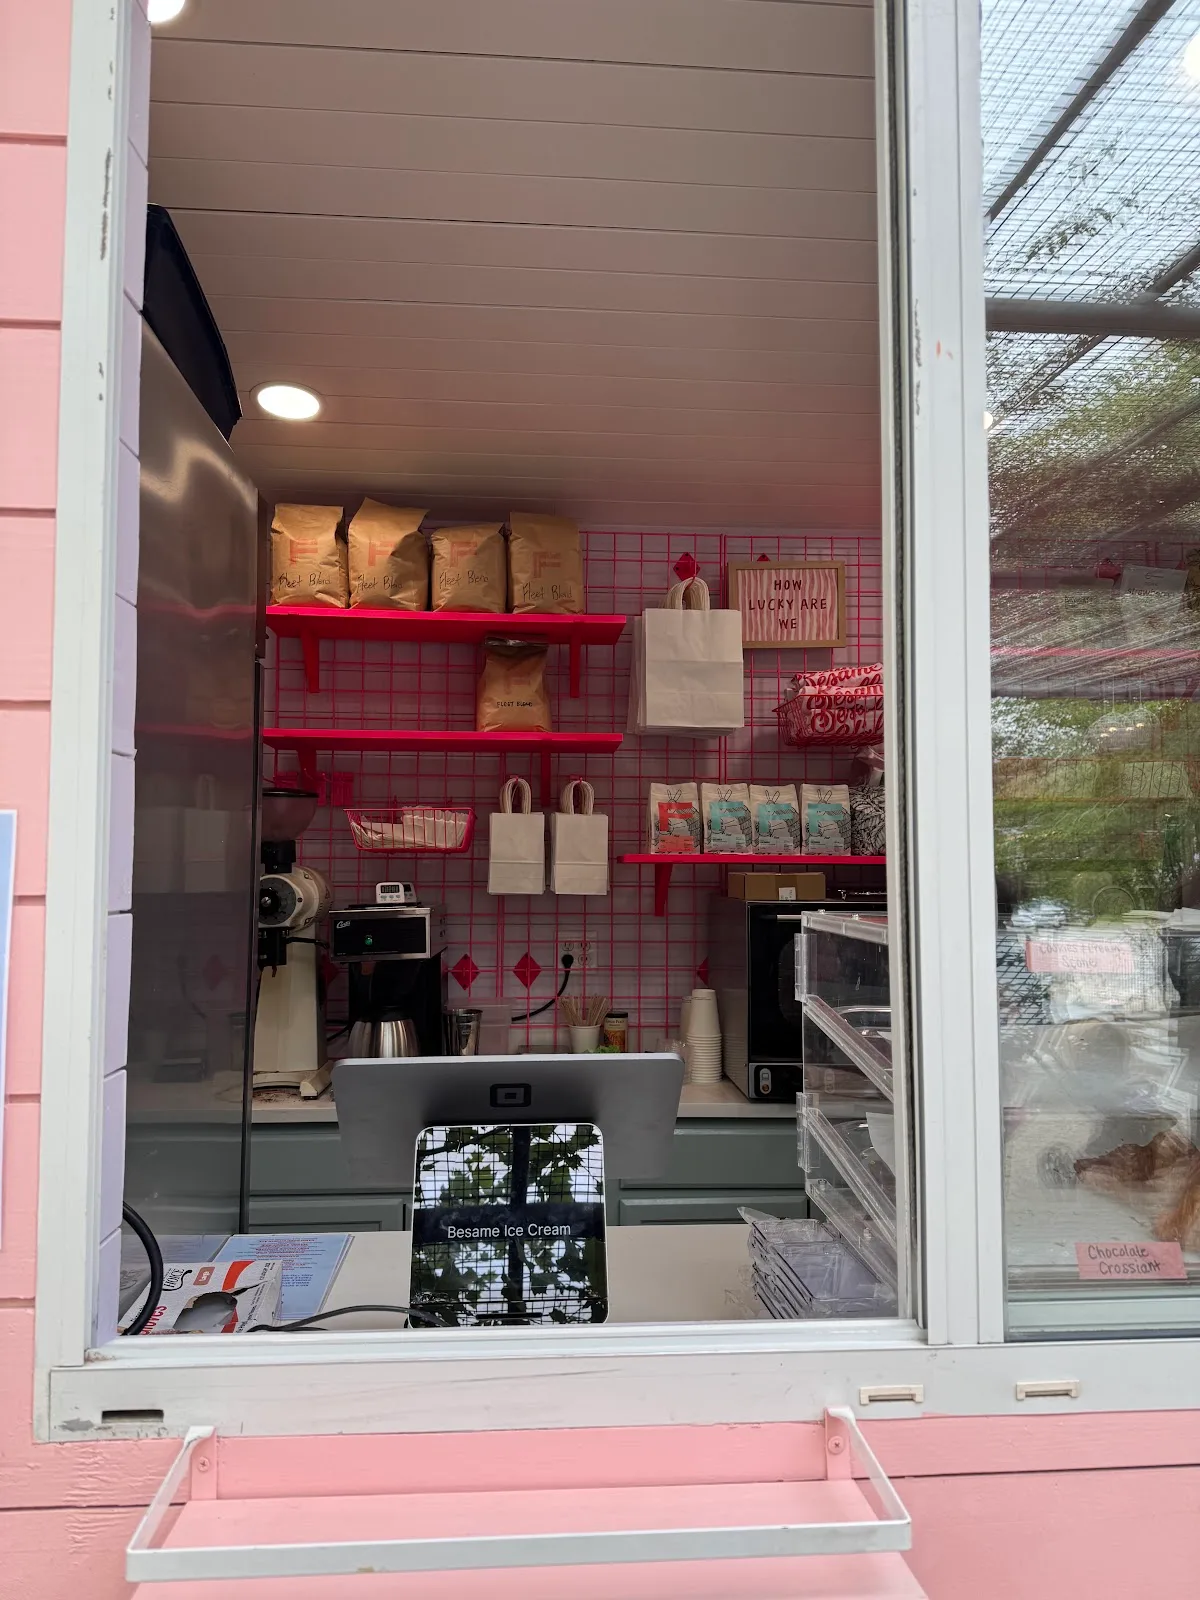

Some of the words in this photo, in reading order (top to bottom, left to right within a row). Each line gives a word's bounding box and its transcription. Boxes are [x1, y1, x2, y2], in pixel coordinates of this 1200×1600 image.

[289, 539, 318, 567] F
[368, 540, 396, 567] F
[450, 541, 477, 568] F
[532, 552, 561, 578] F
[774, 579, 802, 591] HOW
[748, 598, 794, 611] LUCKY
[800, 598, 827, 611] ARE
[778, 617, 798, 630] WE
[658, 802, 693, 831] F
[709, 801, 745, 830] F
[758, 803, 793, 832] F
[808, 803, 843, 832] F
[447, 1225, 500, 1239] Besame
[504, 1224, 524, 1237] Ice
[527, 1223, 571, 1236] Cream
[1088, 1245, 1149, 1260] Chocolate
[1099, 1259, 1161, 1275] Crossiant
